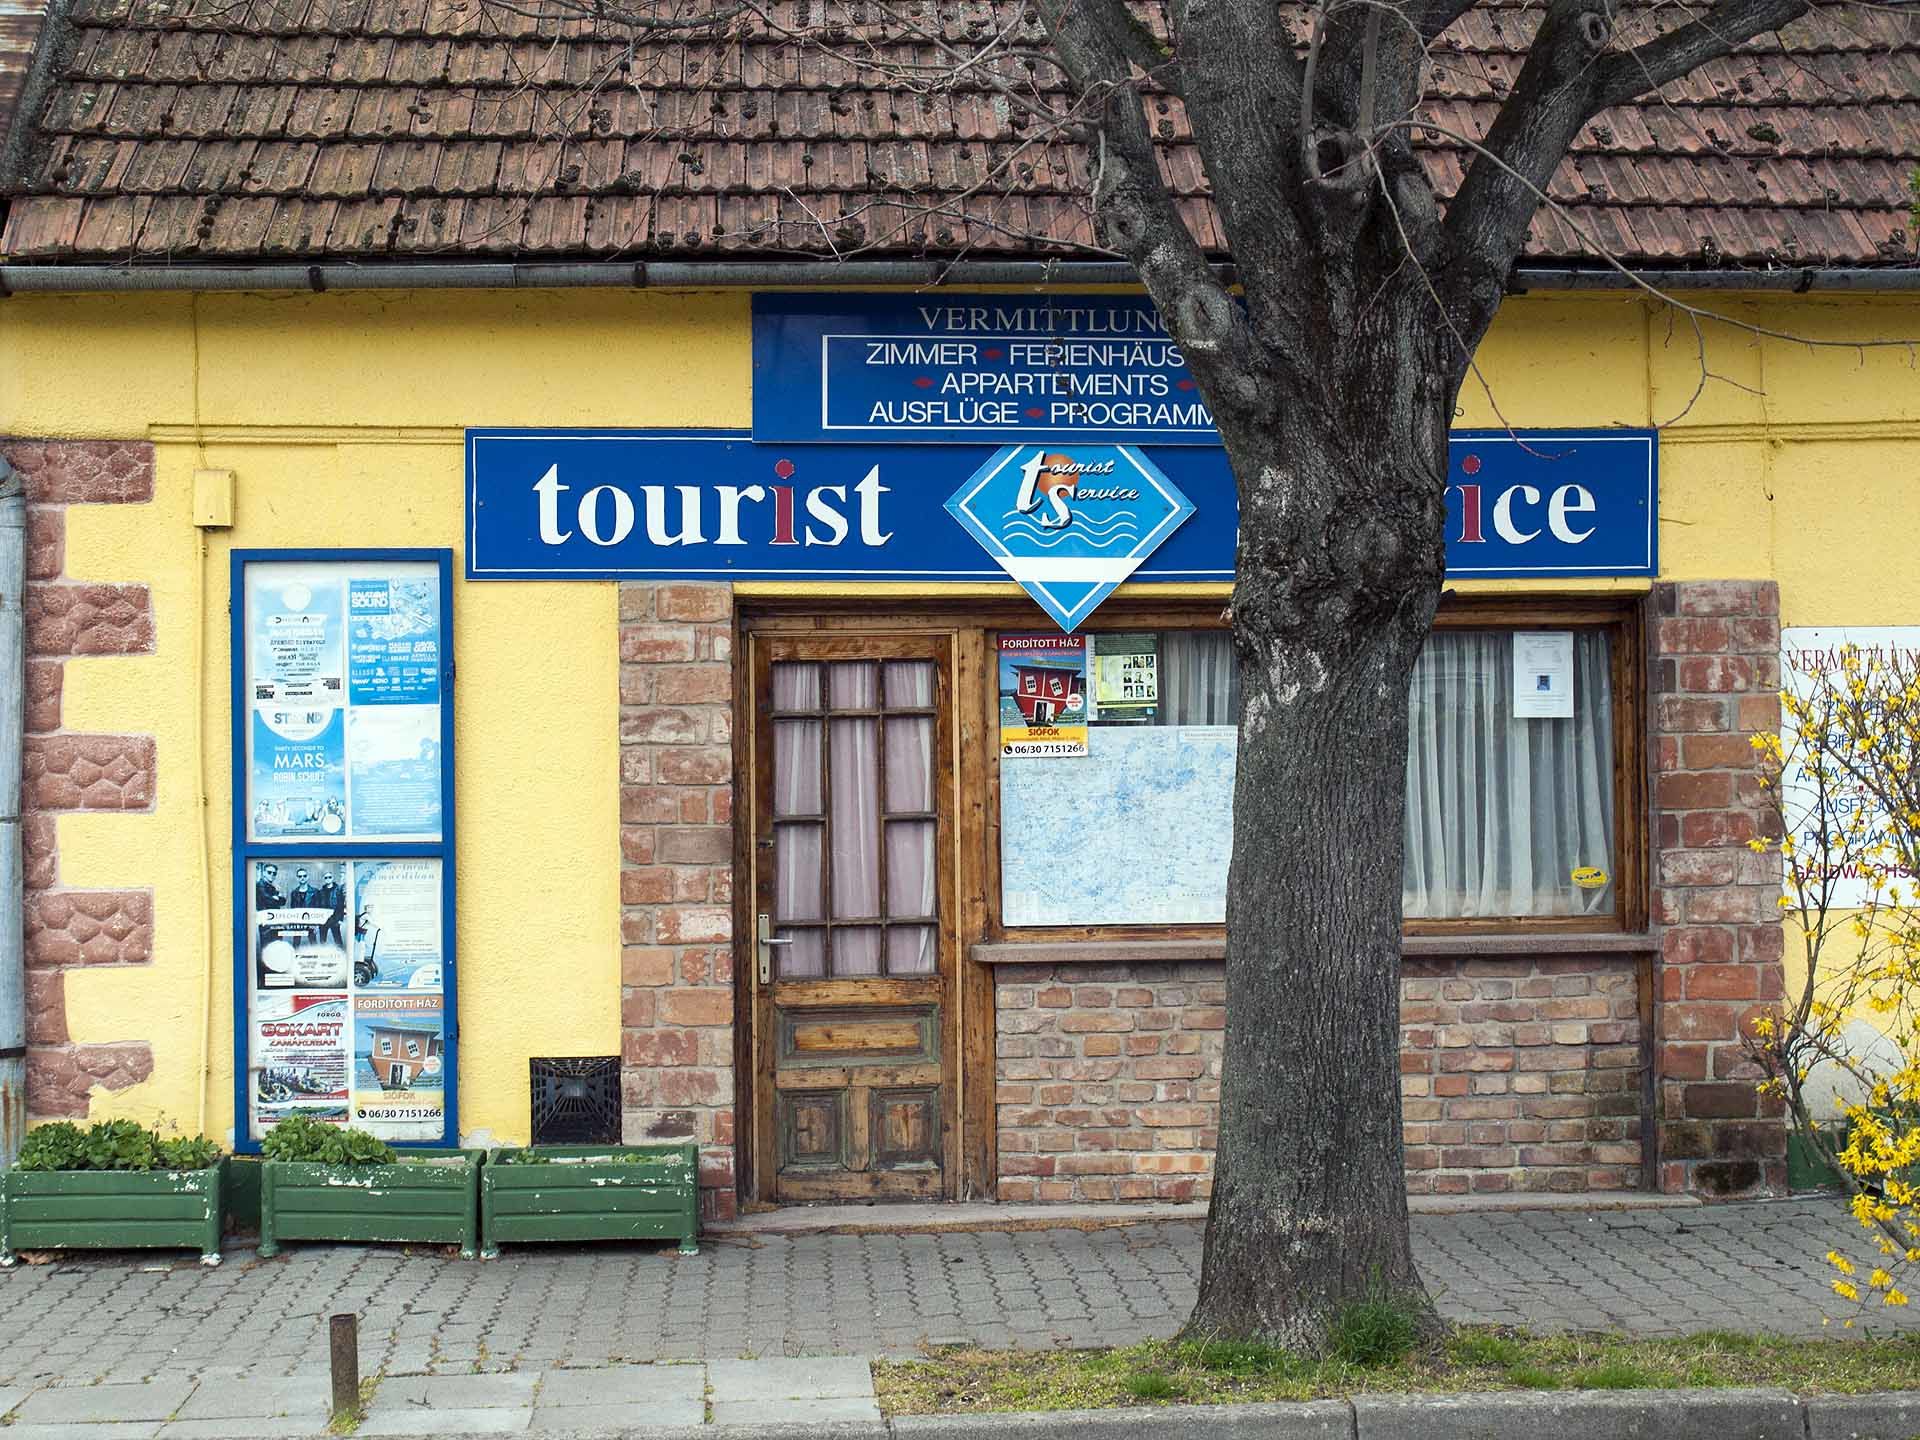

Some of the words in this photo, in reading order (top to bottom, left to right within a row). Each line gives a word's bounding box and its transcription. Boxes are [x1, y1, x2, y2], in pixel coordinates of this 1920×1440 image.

[866, 343, 978, 365] ZIMMER
[1010, 341, 1185, 368] FERIENHÄUS
[940, 373, 1170, 397] APPARTEMENTS
[868, 397, 1020, 424] AUSFLÜGE
[532, 458, 894, 547] tourist
[1002, 637, 1057, 649] FORDÍTOTT
[1059, 637, 1080, 648] HÁZ
[1028, 727, 1059, 736] SIÓFOK
[1014, 745, 1042, 754] 06/30
[1043, 743, 1085, 754] 7151266
[274, 753, 325, 769] MARS
[368, 1109, 397, 1119] 06/30
[398, 1108, 442, 1119] 7151266
